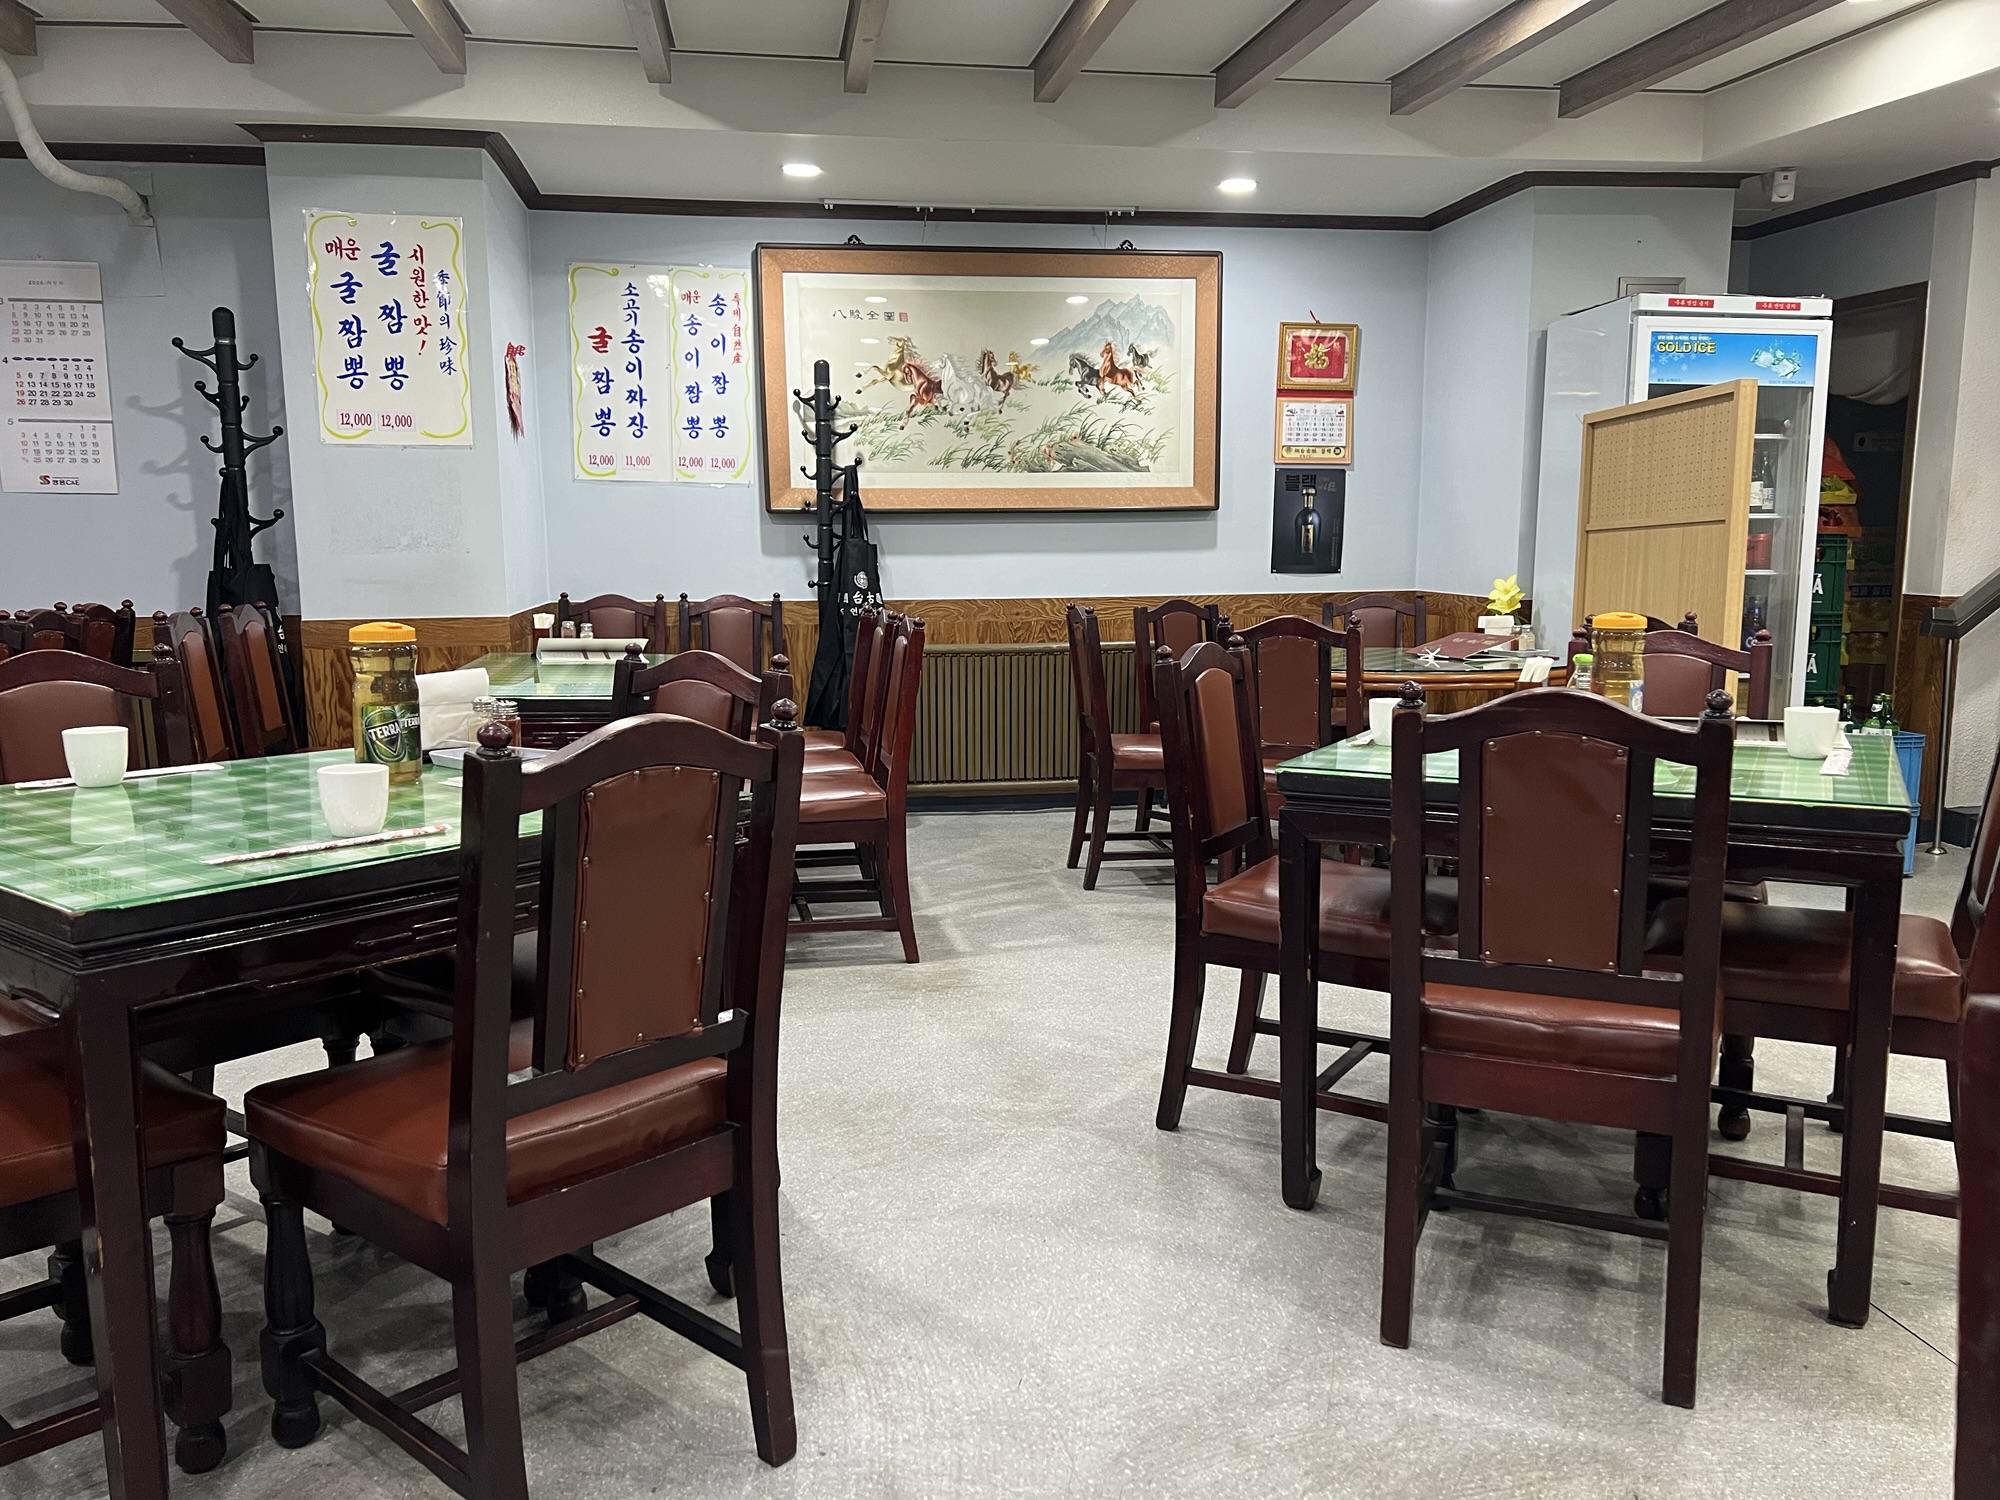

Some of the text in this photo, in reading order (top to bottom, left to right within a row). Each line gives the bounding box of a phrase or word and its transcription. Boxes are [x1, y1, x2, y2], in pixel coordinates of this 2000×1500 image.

[325, 236, 368, 390] 매운 굴짬뽕
[371, 242, 409, 390] 굴짬뽕
[1657, 342, 1716, 354] GOLD ICE
[680, 290, 704, 439] 매운 송이짬뽕
[707, 293, 730, 439] 송이짬뽕
[587, 326, 617, 438] 굴짬뽕
[340, 413, 372, 427] 12,000
[381, 414, 412, 428] 12,000
[588, 454, 614, 466] 12,000
[625, 455, 650, 466] 11,000
[678, 456, 703, 468] 12,000
[710, 458, 735, 470] 12,000
[368, 722, 401, 740] TERRA
